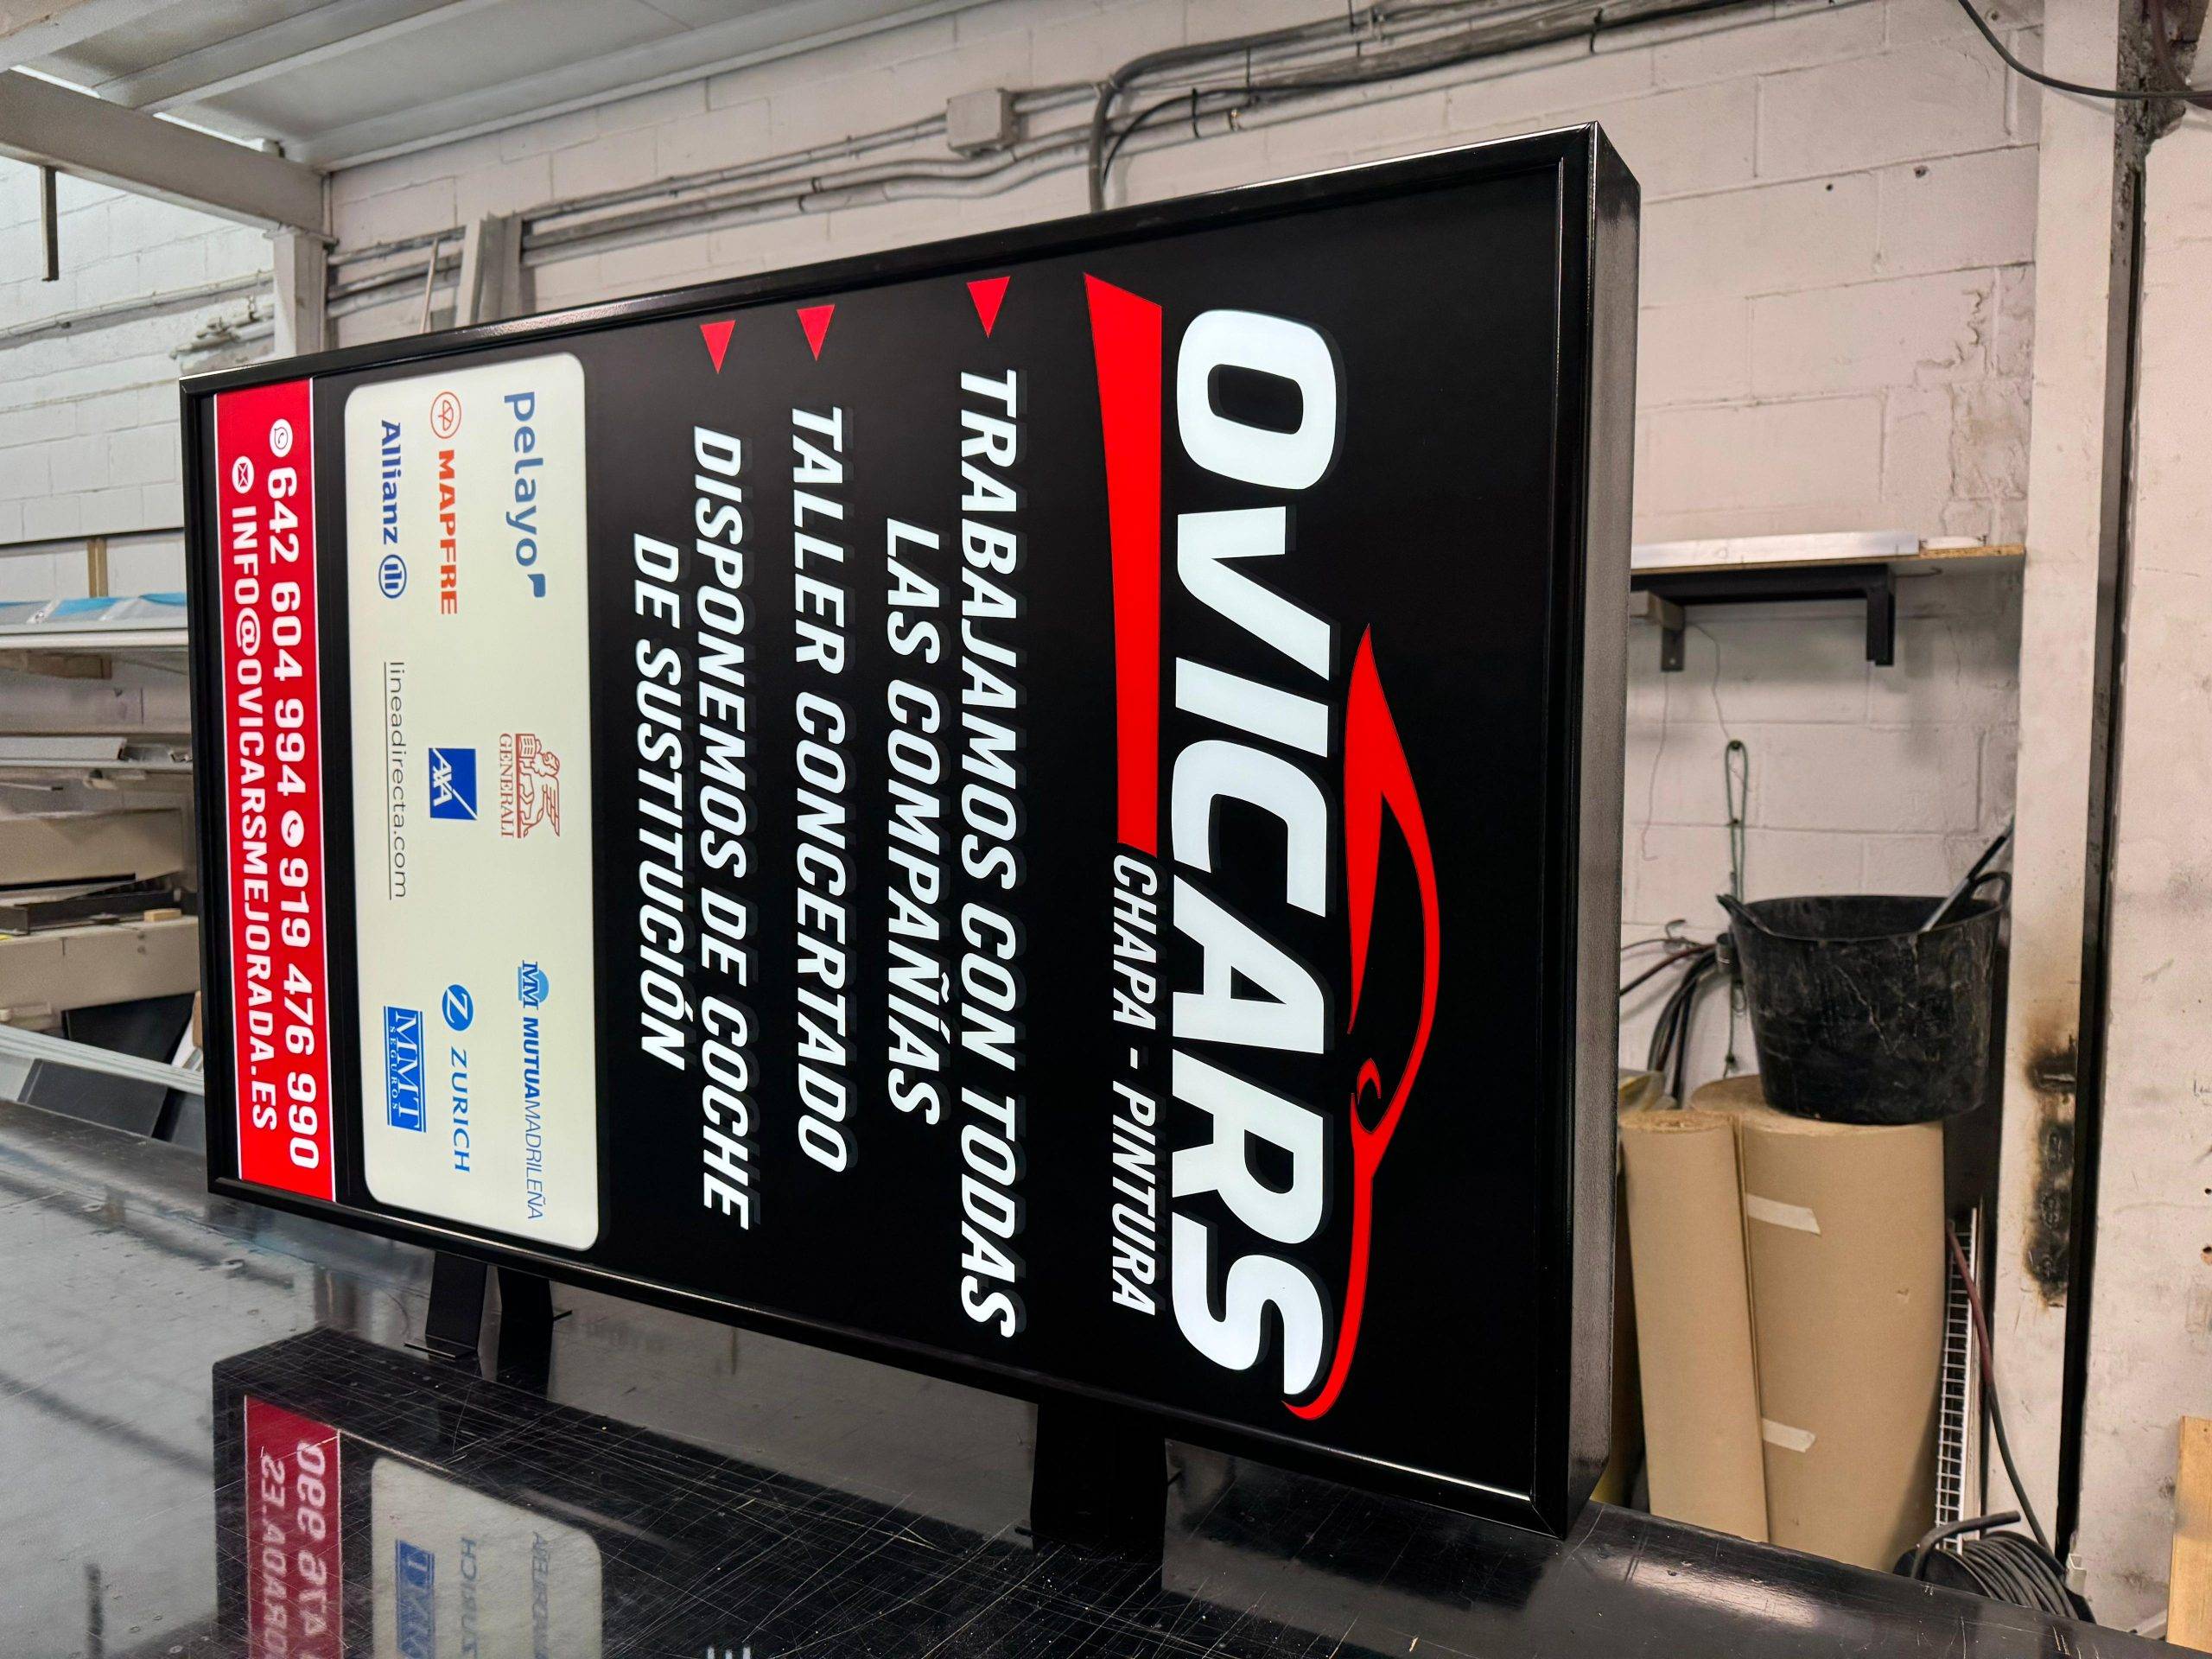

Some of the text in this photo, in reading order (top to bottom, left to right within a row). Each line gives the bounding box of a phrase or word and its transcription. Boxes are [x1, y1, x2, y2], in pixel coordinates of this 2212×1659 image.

[381, 419, 402, 544] Allianz
[438, 448, 458, 614] MAPFRE
[504, 391, 544, 567] pelayo
[232, 505, 276, 1130] INFO@OVICARSMEJORADA.ES
[268, 467, 319, 1168] 642 604 994 919 476 990
[390, 662, 406, 899] lineadirecta.com
[499, 733, 515, 838] GENERALI
[635, 534, 693, 1070] DE SUSTITUCIÓN
[695, 427, 748, 1230] DISPONEMOS DE COCHE
[792, 407, 847, 1172] TALLER CONCERTADO
[887, 518, 950, 1124] LAS COMPAÑÍAS
[962, 370, 1016, 1337] TRABAJAMOS CON TODAS
[1172, 310, 1336, 1394] OVICARS
[1113, 855, 1157, 1030] CHAPA
[390, 1026, 398, 1109] SEGUROS
[395, 1011, 420, 1128] MMT
[450, 1046, 471, 1173] ZURICH
[523, 1016, 546, 1219] MUTUAMADRILEÑA
[1113, 1081, 1155, 1315] PINTURA
